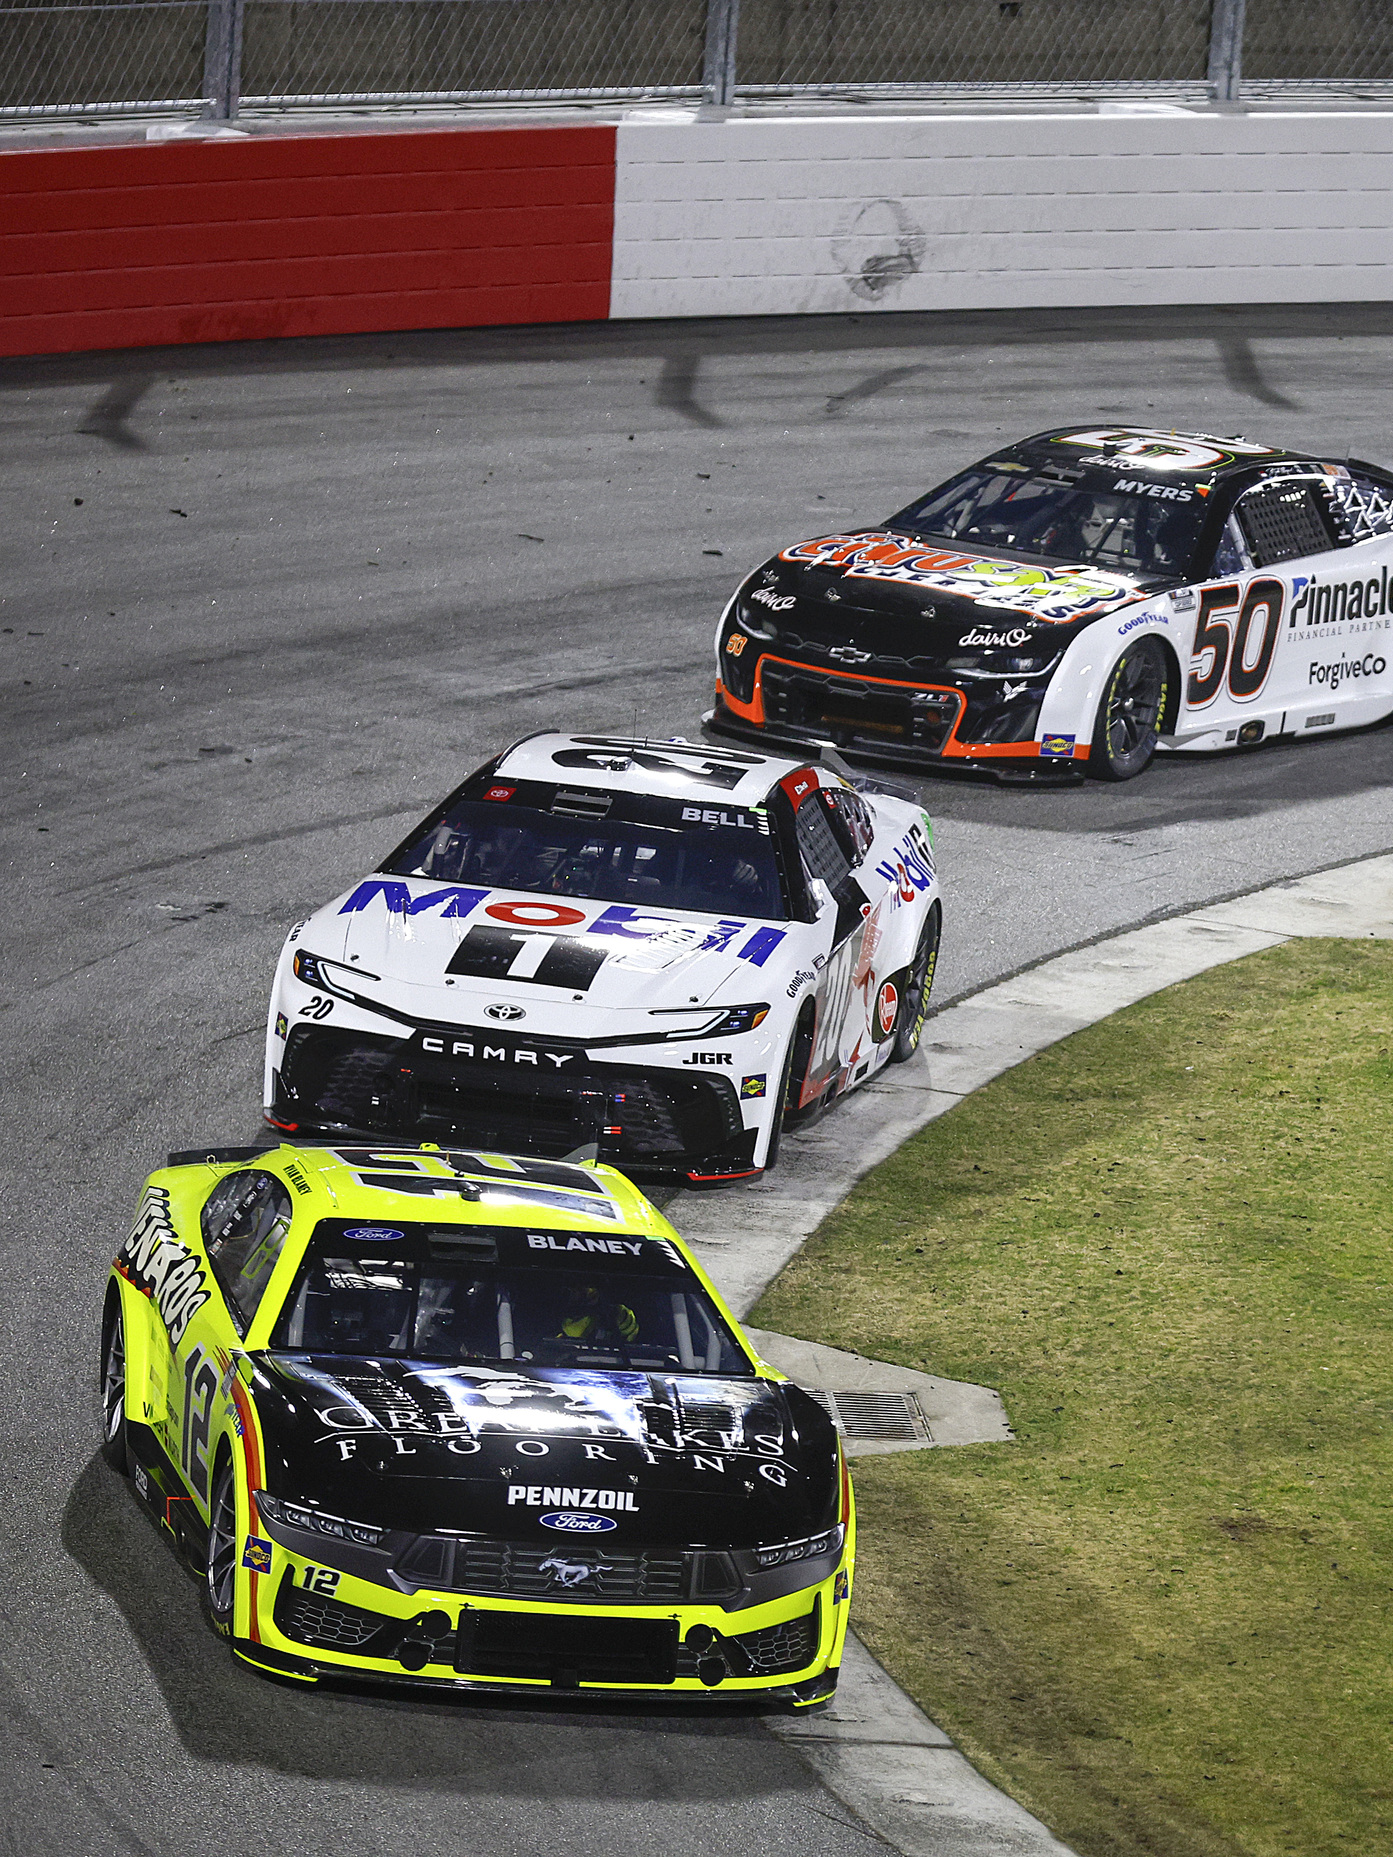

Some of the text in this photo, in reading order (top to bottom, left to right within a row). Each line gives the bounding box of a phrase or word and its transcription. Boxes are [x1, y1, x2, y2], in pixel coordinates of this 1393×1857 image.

[1113, 479, 1194, 502] MYERS
[1118, 611, 1170, 636] GOODYEAR
[1287, 626, 1342, 643] FINANCIAL
[726, 633, 748, 657] 50
[958, 628, 1032, 647] dairiO
[1186, 575, 1285, 709] 50
[1309, 651, 1386, 690] ForgiveCo
[912, 692, 950, 702] ZL1
[1043, 740, 1074, 750] SUNOCO
[681, 806, 754, 829] BELL
[298, 995, 334, 1020] 20
[422, 1037, 574, 1068] CAMRY
[682, 1052, 734, 1066] JGR
[354, 1228, 393, 1241] Ford
[527, 1234, 643, 1256] BLANEY
[181, 1340, 220, 1512] 12
[508, 1485, 640, 1512] PENNZOIL
[555, 1512, 602, 1531] Ford
[302, 1565, 341, 1597] 12
